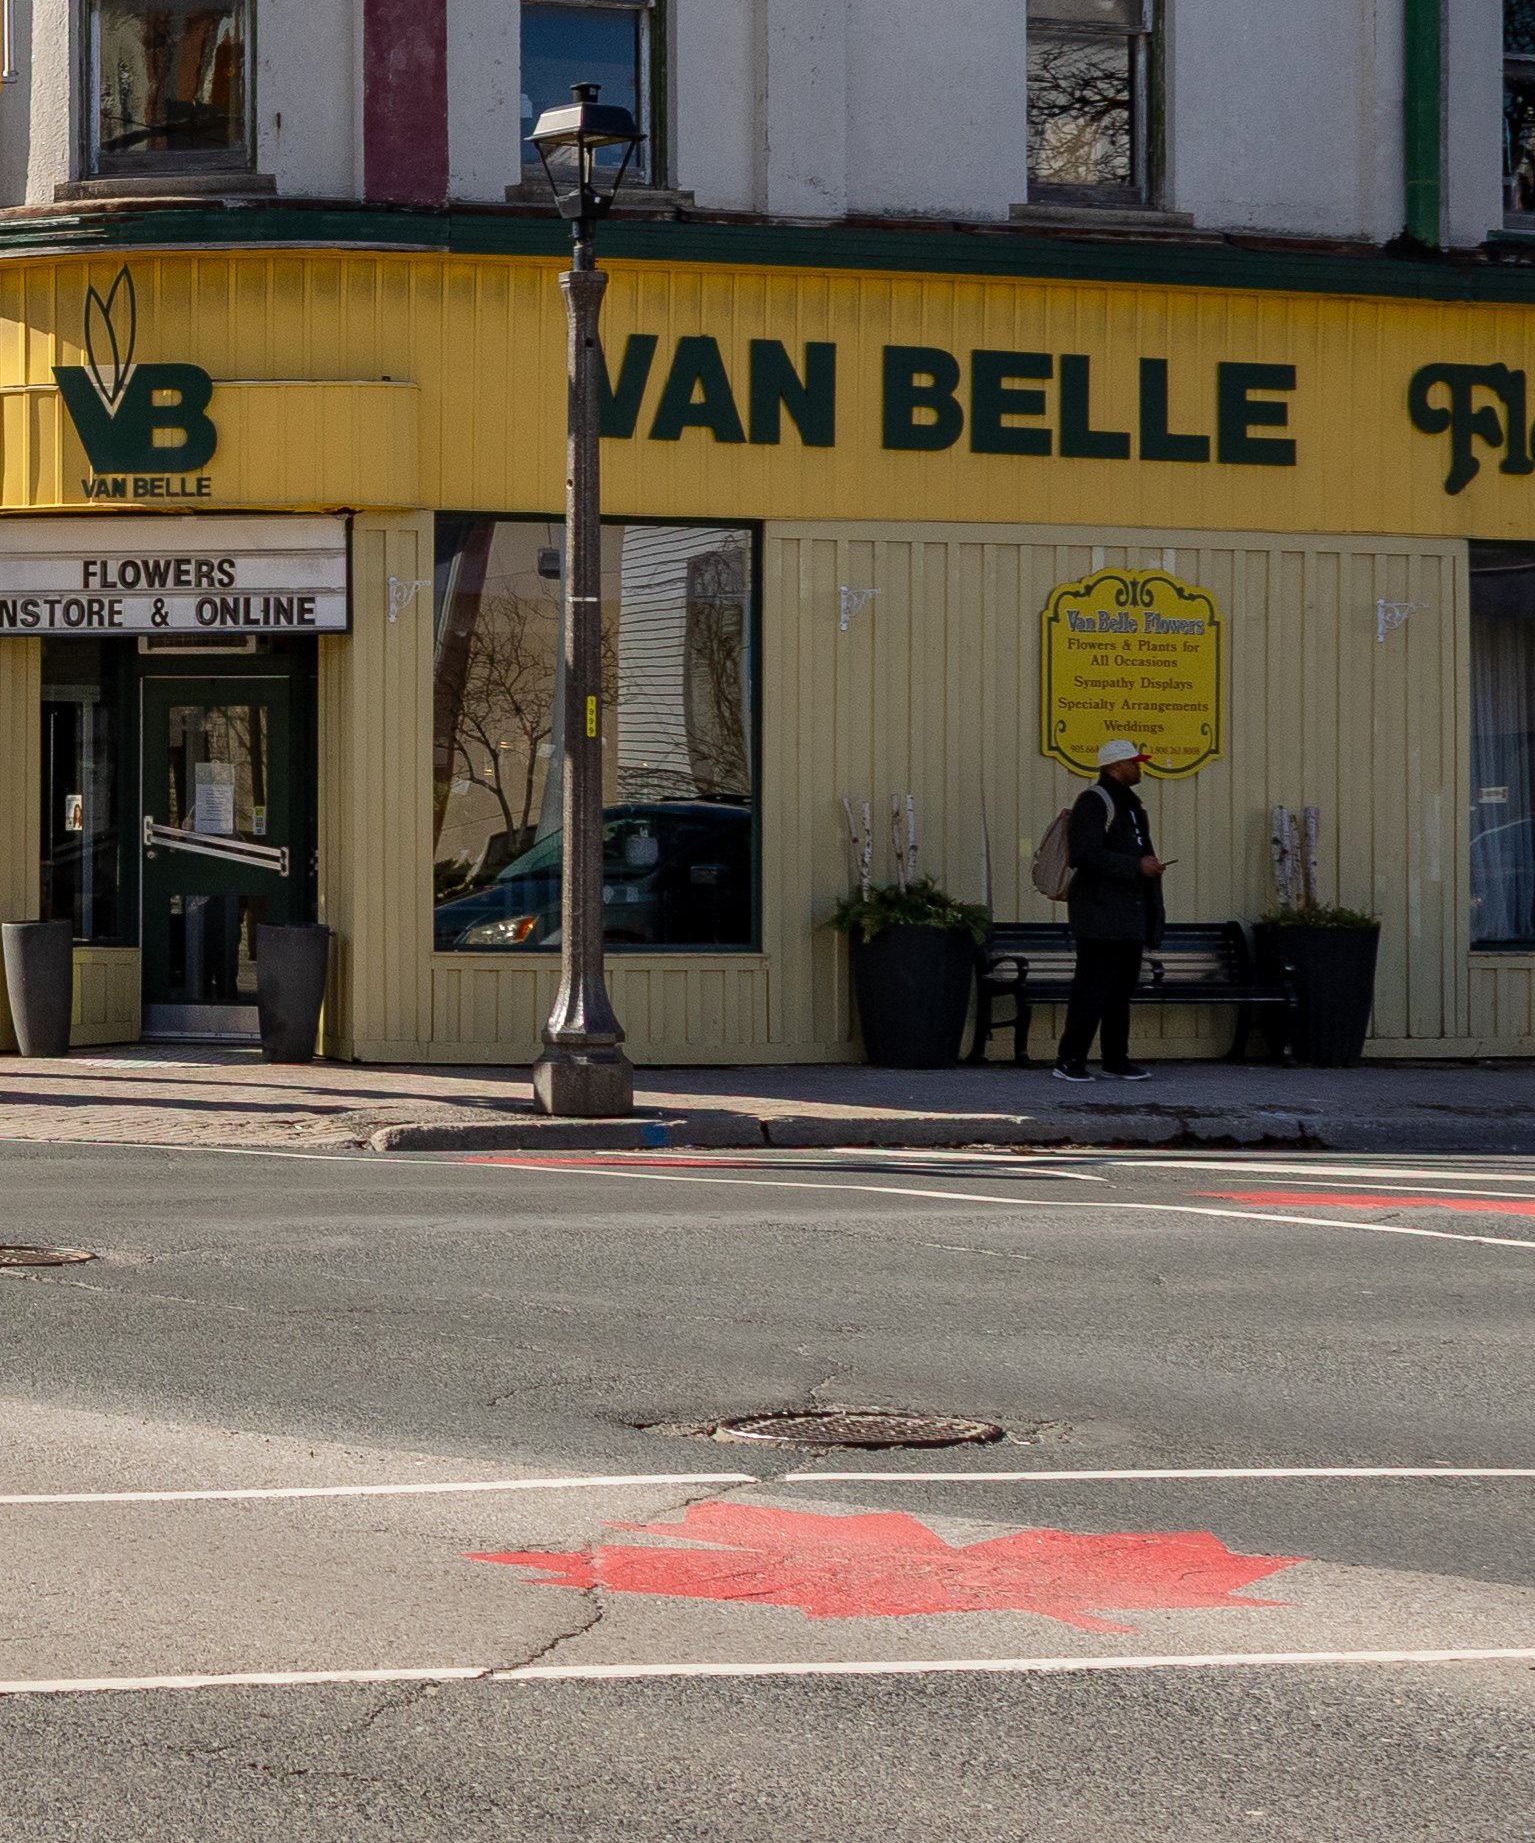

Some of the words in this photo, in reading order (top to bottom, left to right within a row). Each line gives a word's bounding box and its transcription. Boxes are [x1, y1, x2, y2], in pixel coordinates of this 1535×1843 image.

[599, 334, 835, 448] VAN
[880, 344, 1297, 467] BELLE
[51, 363, 217, 474] VB
[81, 477, 126, 498] VAN
[133, 477, 211, 498] BELLE
[82, 558, 236, 588] FLOWERS
[150, 598, 170, 627] &
[196, 597, 316, 626] ONLINE
[1067, 610, 1096, 632] Van
[1097, 611, 1137, 633] Belle
[1143, 611, 1205, 635] Flowers
[1067, 638, 1116, 651] Flowers
[1122, 640, 1132, 651] &
[1138, 640, 1177, 652] Plants
[1183, 641, 1201, 652] for
[1090, 655, 1109, 666] All
[1114, 655, 1178, 668] Occasions
[1074, 676, 1135, 690] Sympathy
[1141, 677, 1193, 691] Displays
[1058, 697, 1115, 711] Specialty
[1121, 699, 1209, 713] Arrangements
[1104, 720, 1164, 734] Weddings
